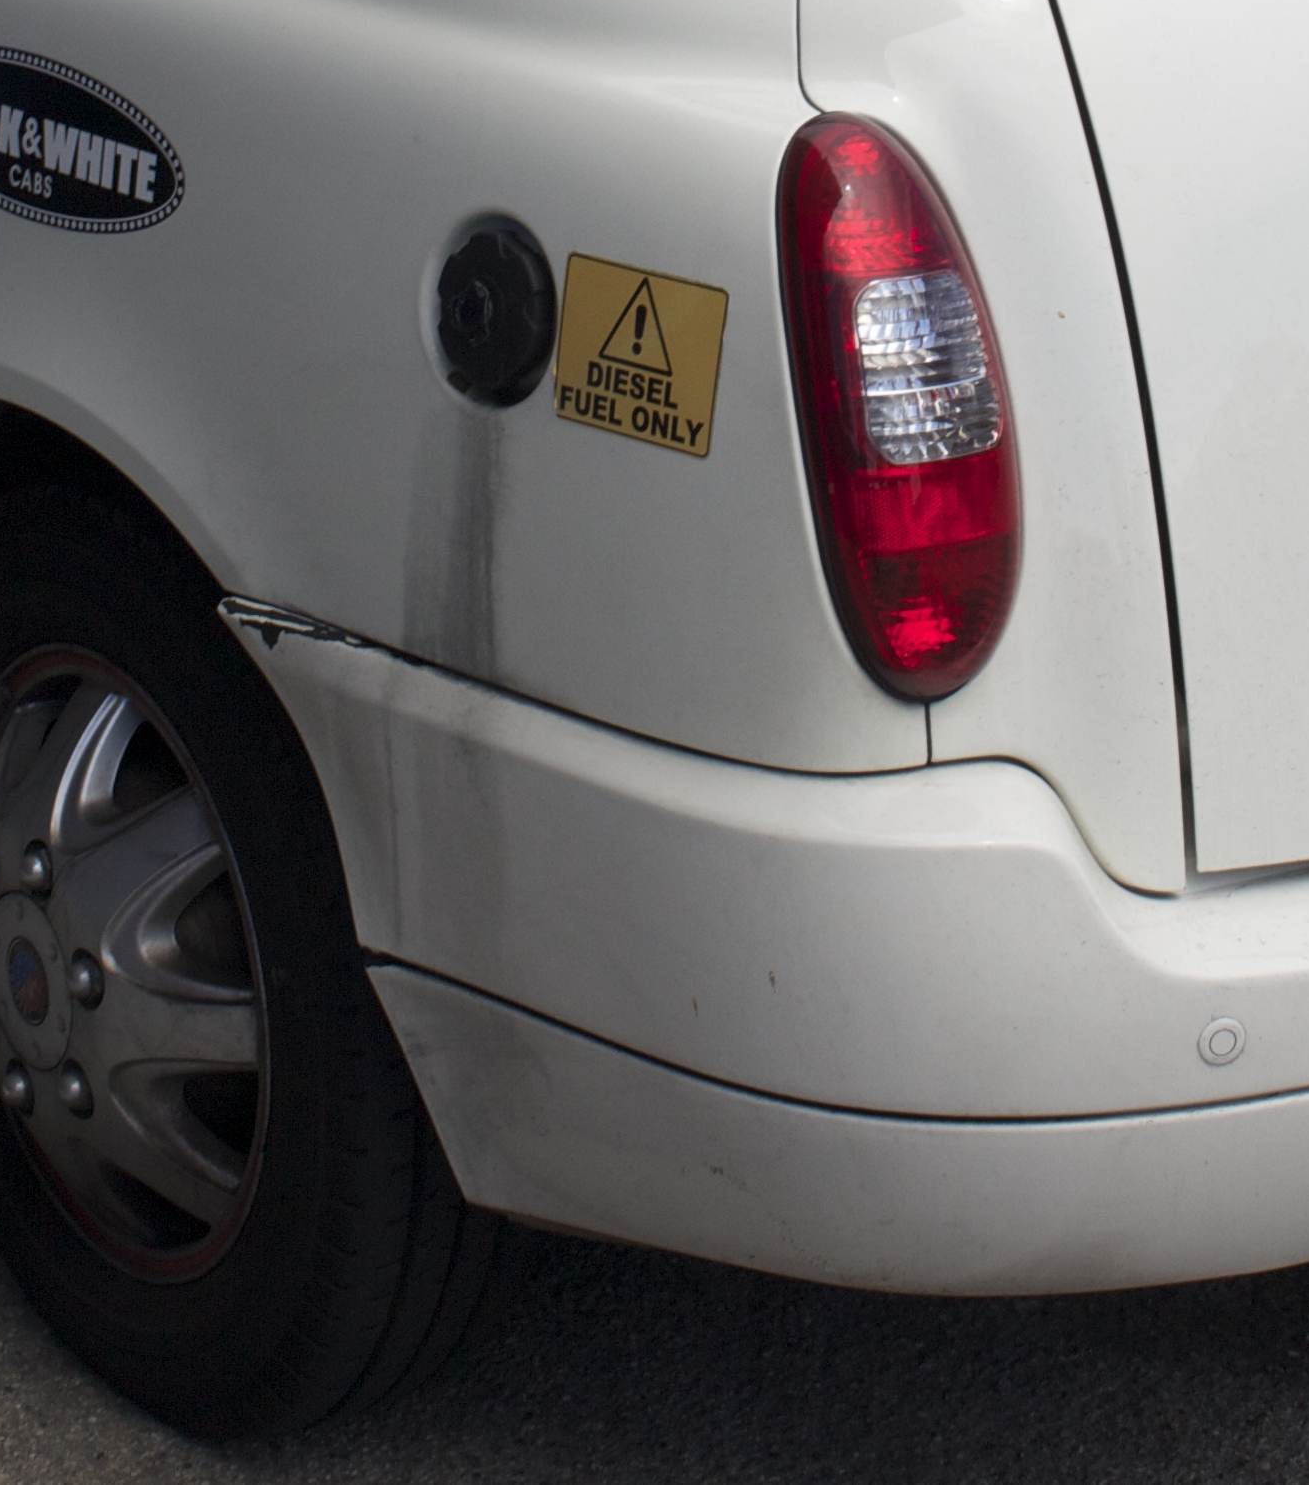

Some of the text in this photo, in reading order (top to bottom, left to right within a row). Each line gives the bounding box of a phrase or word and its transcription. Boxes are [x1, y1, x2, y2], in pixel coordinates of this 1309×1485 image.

[8, 164, 53, 199] CABS
[587, 361, 679, 410] DIESEL
[559, 384, 704, 449] FUEL ONLY
